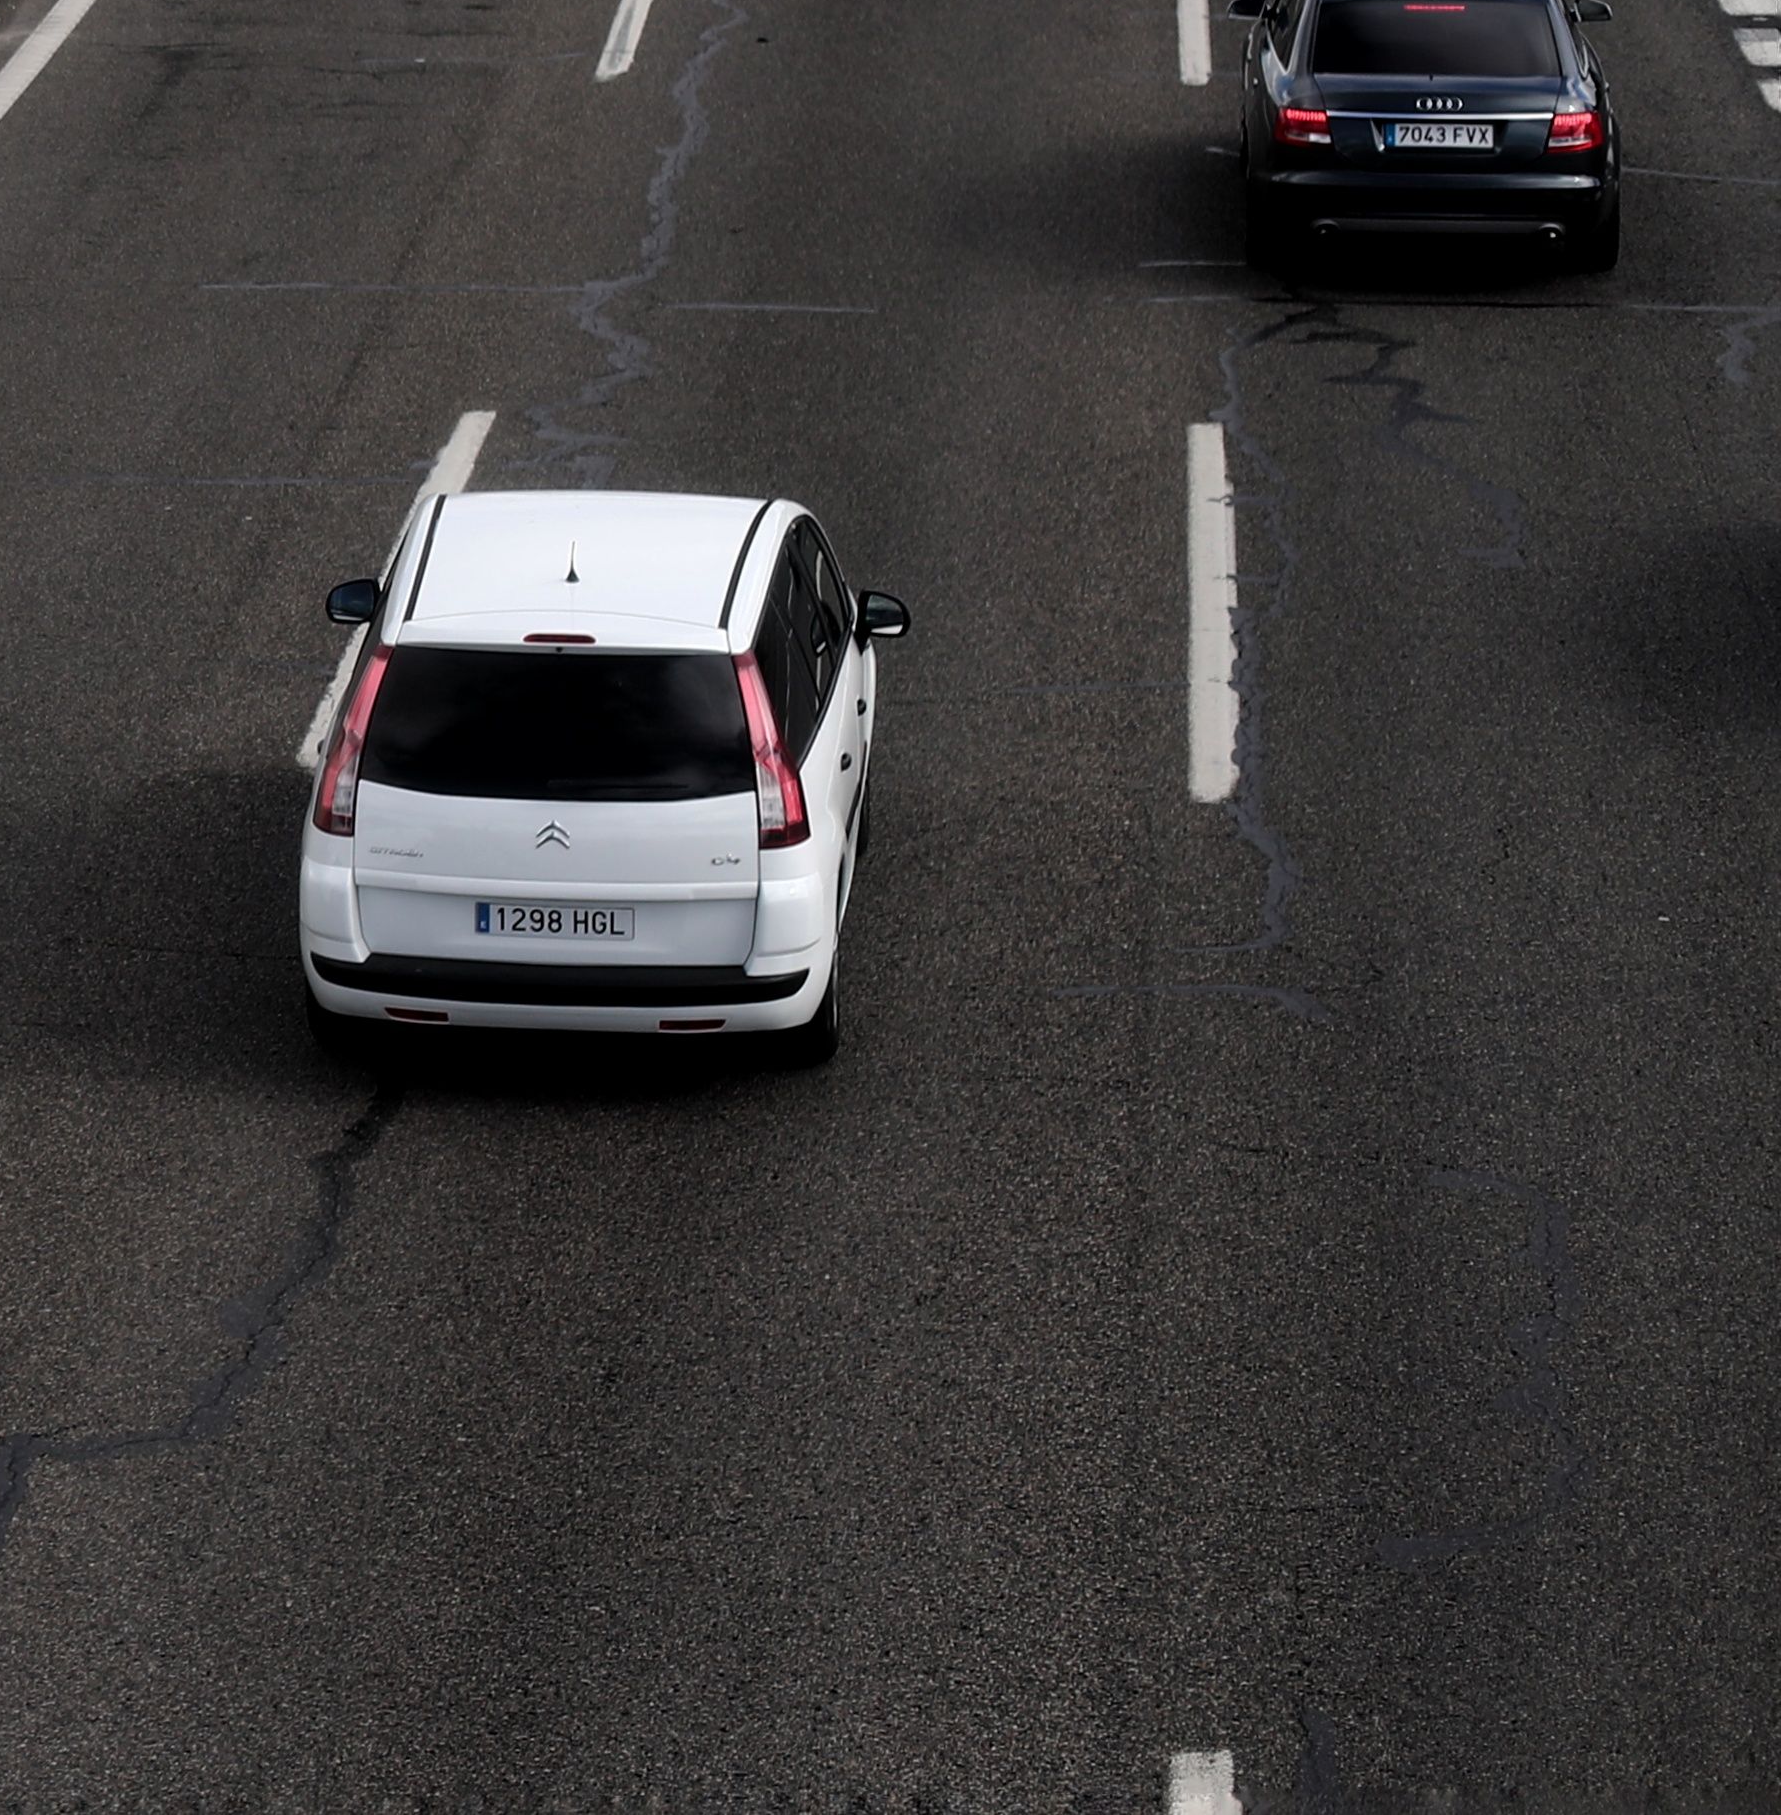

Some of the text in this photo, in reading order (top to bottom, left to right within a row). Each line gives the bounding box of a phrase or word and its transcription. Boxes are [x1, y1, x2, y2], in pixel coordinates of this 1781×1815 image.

[1399, 126, 1489, 145] 7043 FVX
[497, 907, 563, 933] 1298
[573, 910, 625, 935] HGL
